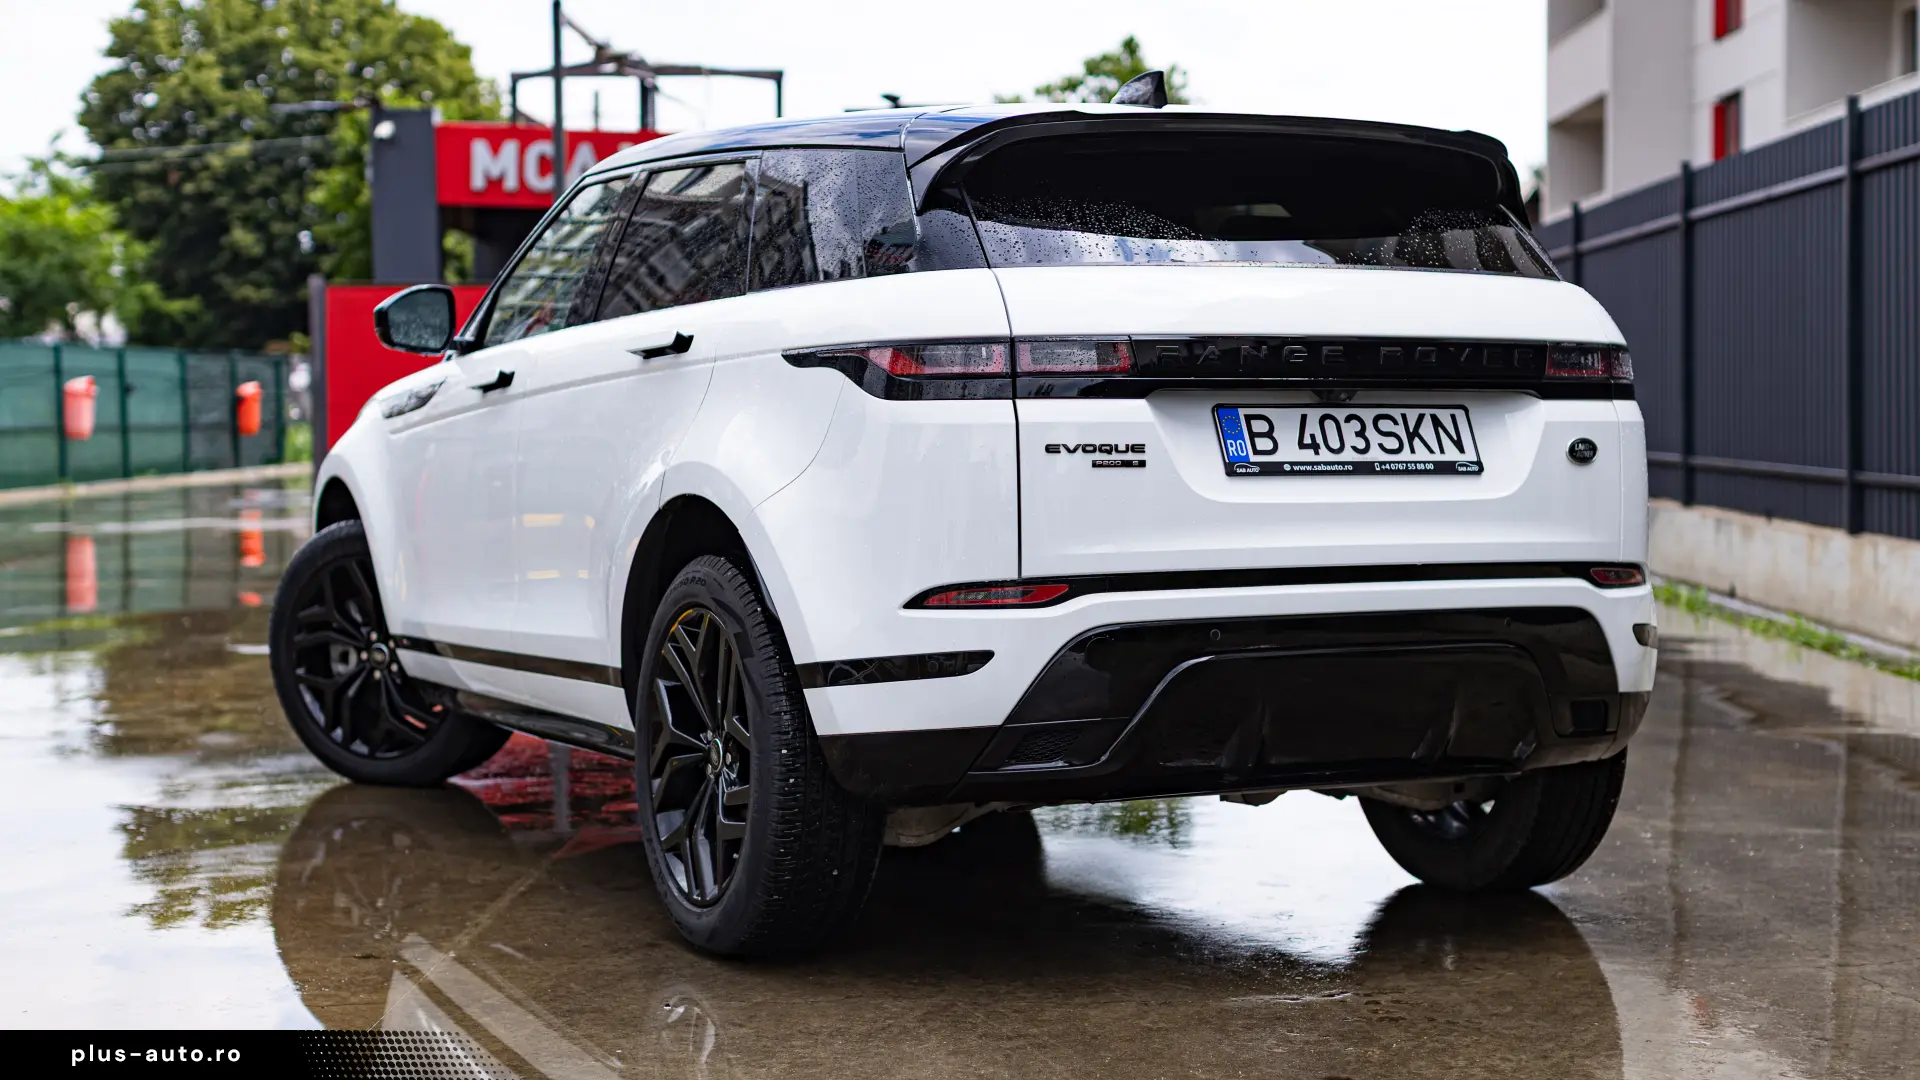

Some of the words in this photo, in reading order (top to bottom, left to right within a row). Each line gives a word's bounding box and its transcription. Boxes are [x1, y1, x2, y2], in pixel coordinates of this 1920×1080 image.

[469, 137, 633, 194] MCA
[1155, 345, 1345, 365] RANGE
[1380, 346, 1536, 367] ROVER
[1243, 413, 1279, 456] B
[1044, 443, 1146, 455] EVOQUE
[1226, 439, 1247, 457] RO
[1292, 463, 1353, 471] www.sabauto.ro
[1390, 462, 1406, 470] 0767
[1425, 462, 1434, 470] 00
